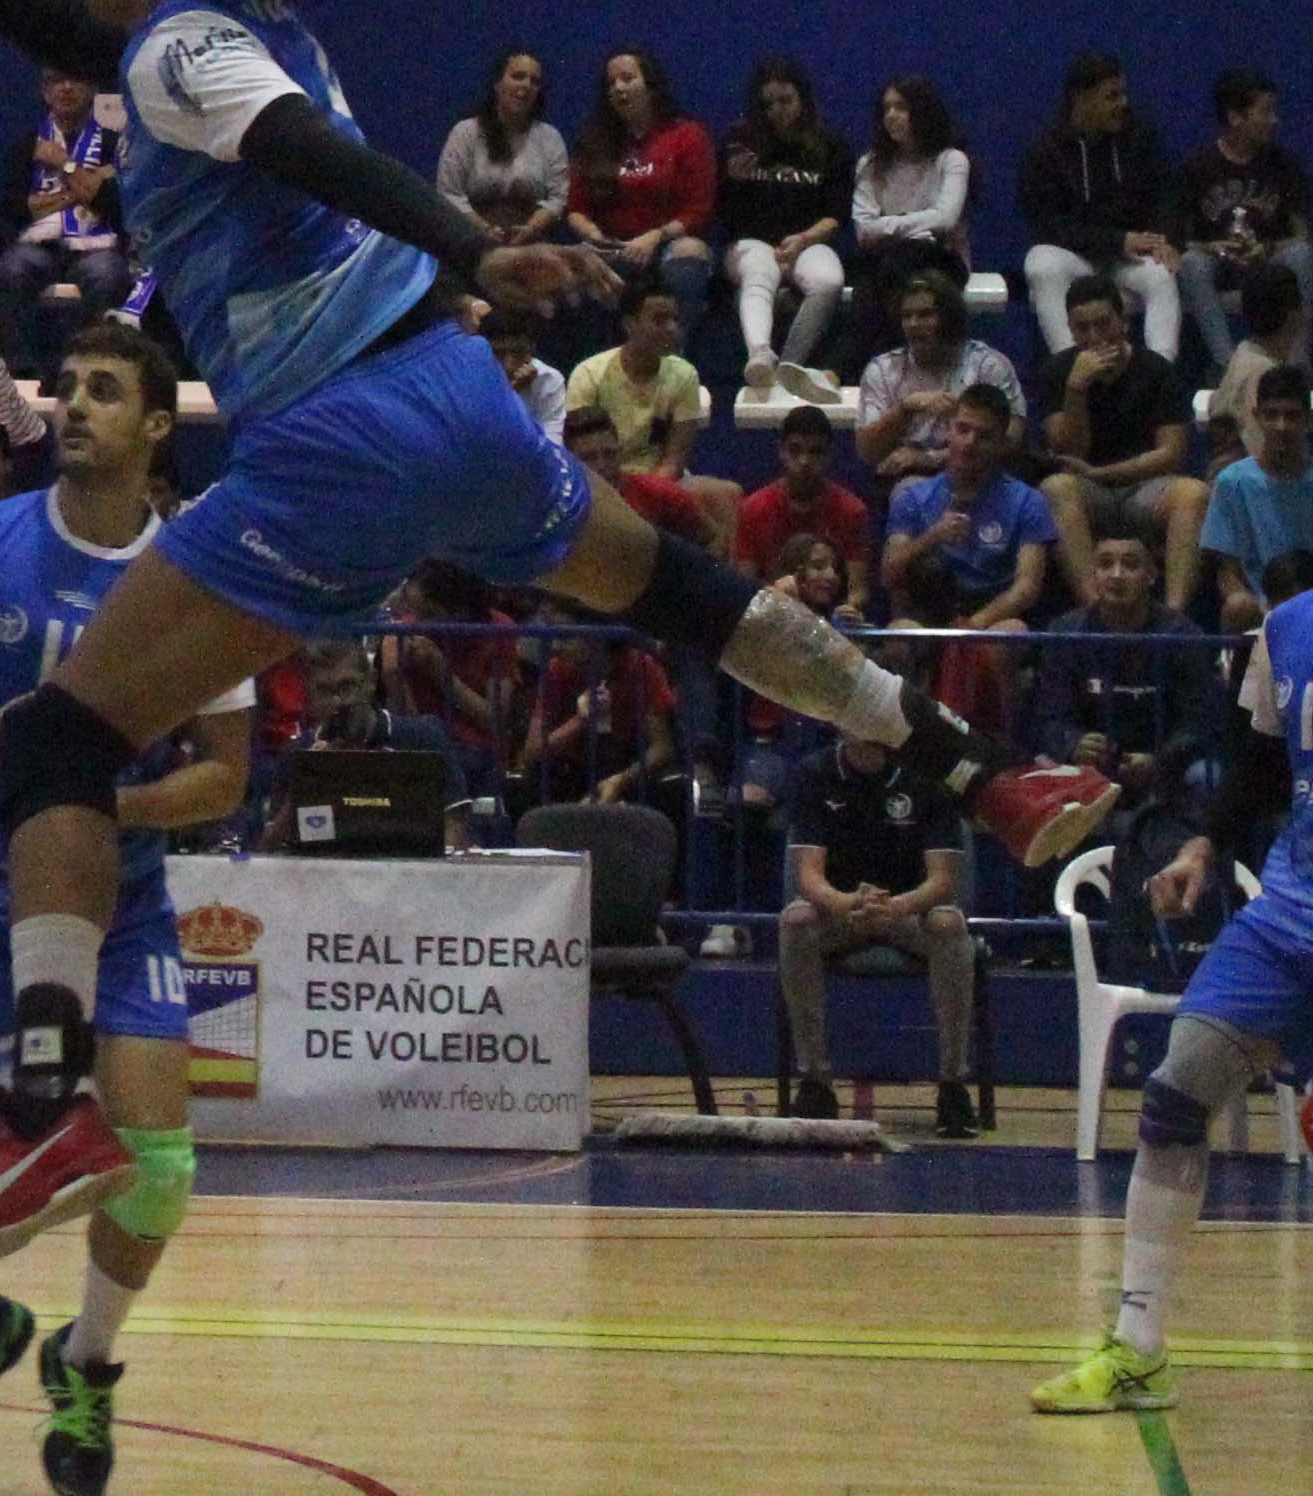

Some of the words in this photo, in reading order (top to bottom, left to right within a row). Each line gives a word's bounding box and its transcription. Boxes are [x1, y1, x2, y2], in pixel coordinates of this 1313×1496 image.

[306, 932, 403, 965] REAL
[147, 955, 188, 1005] 10
[183, 968, 252, 986] RFEVB
[305, 978, 504, 1016] ESPAÑOLA
[305, 1029, 353, 1060] DE
[366, 1030, 552, 1065] VOLEIBOL
